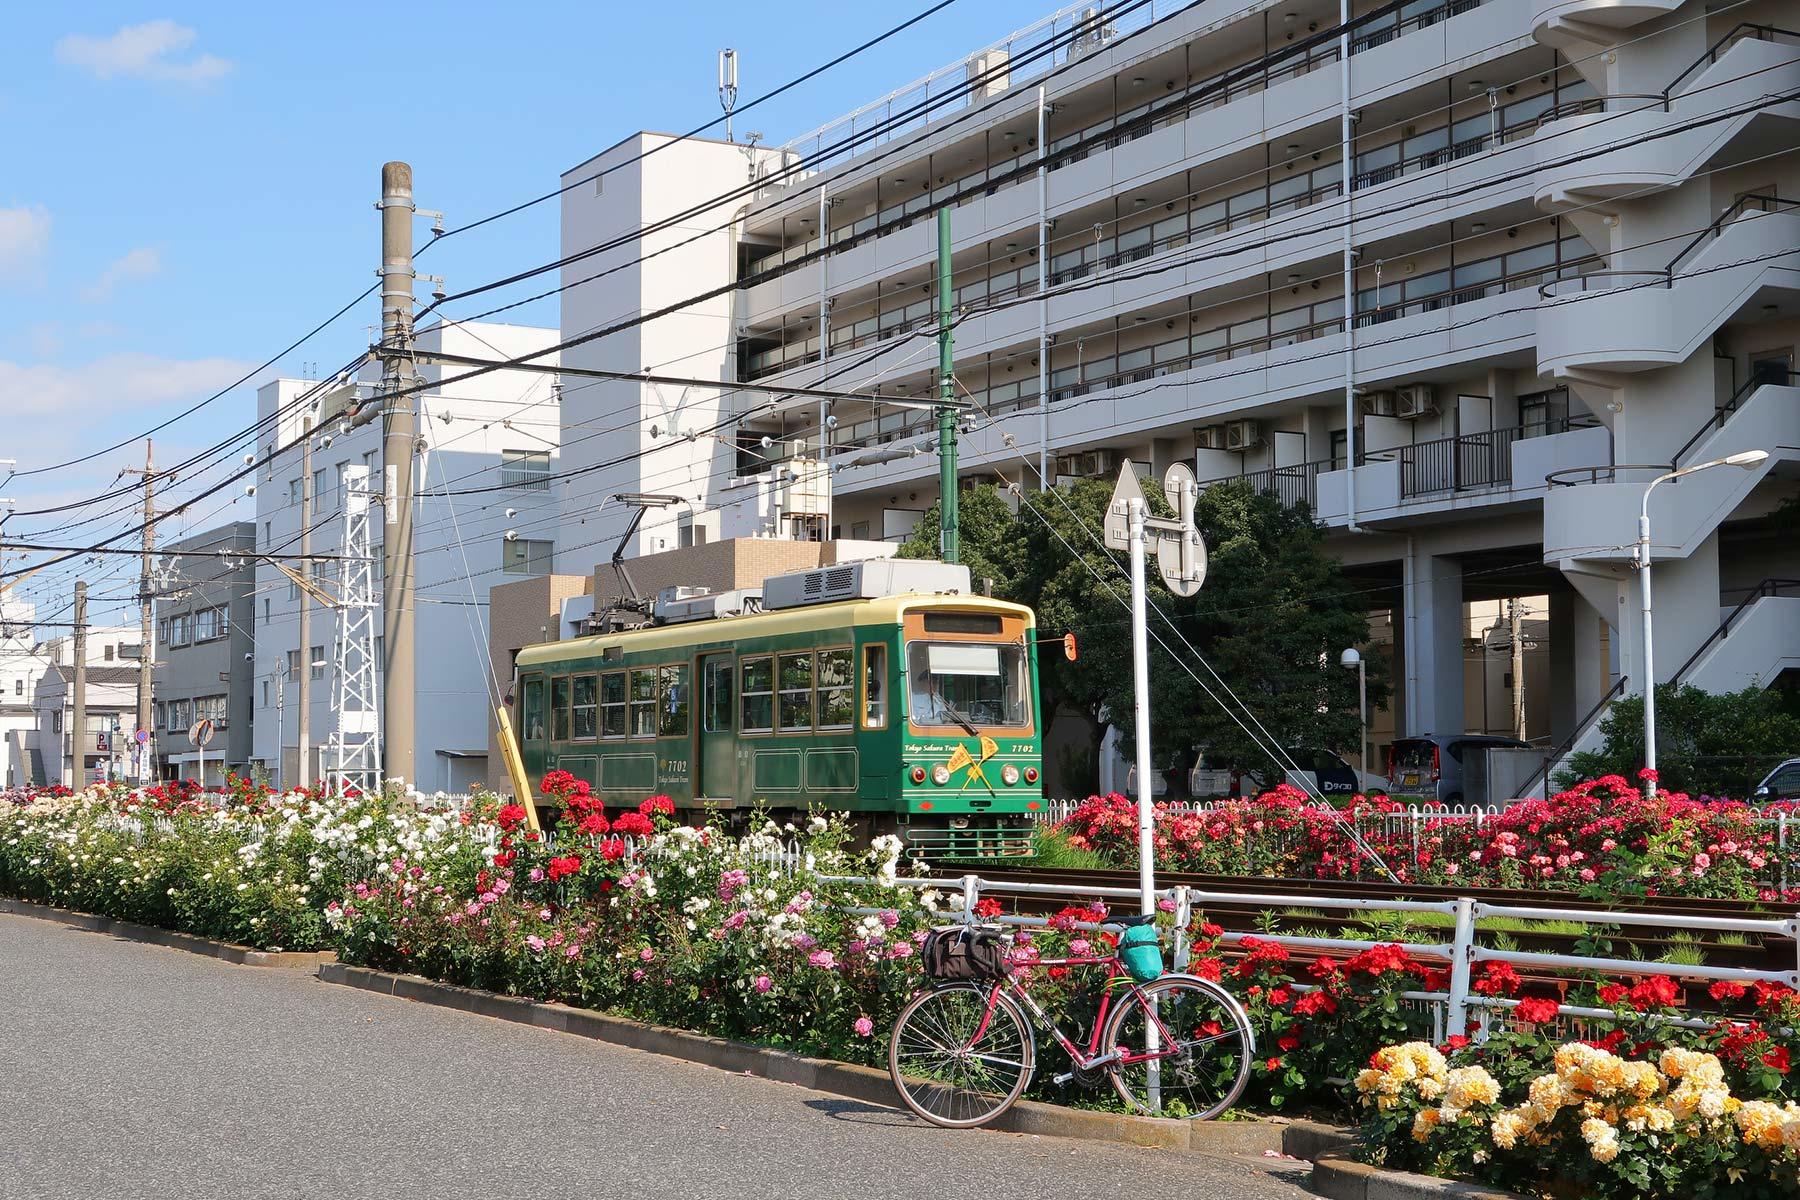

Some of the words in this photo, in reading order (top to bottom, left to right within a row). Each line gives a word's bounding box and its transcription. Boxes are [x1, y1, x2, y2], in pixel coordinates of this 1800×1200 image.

[905, 744, 922, 754] Tokyo
[923, 744, 943, 752] Sakura
[668, 760, 687, 772] 7702
